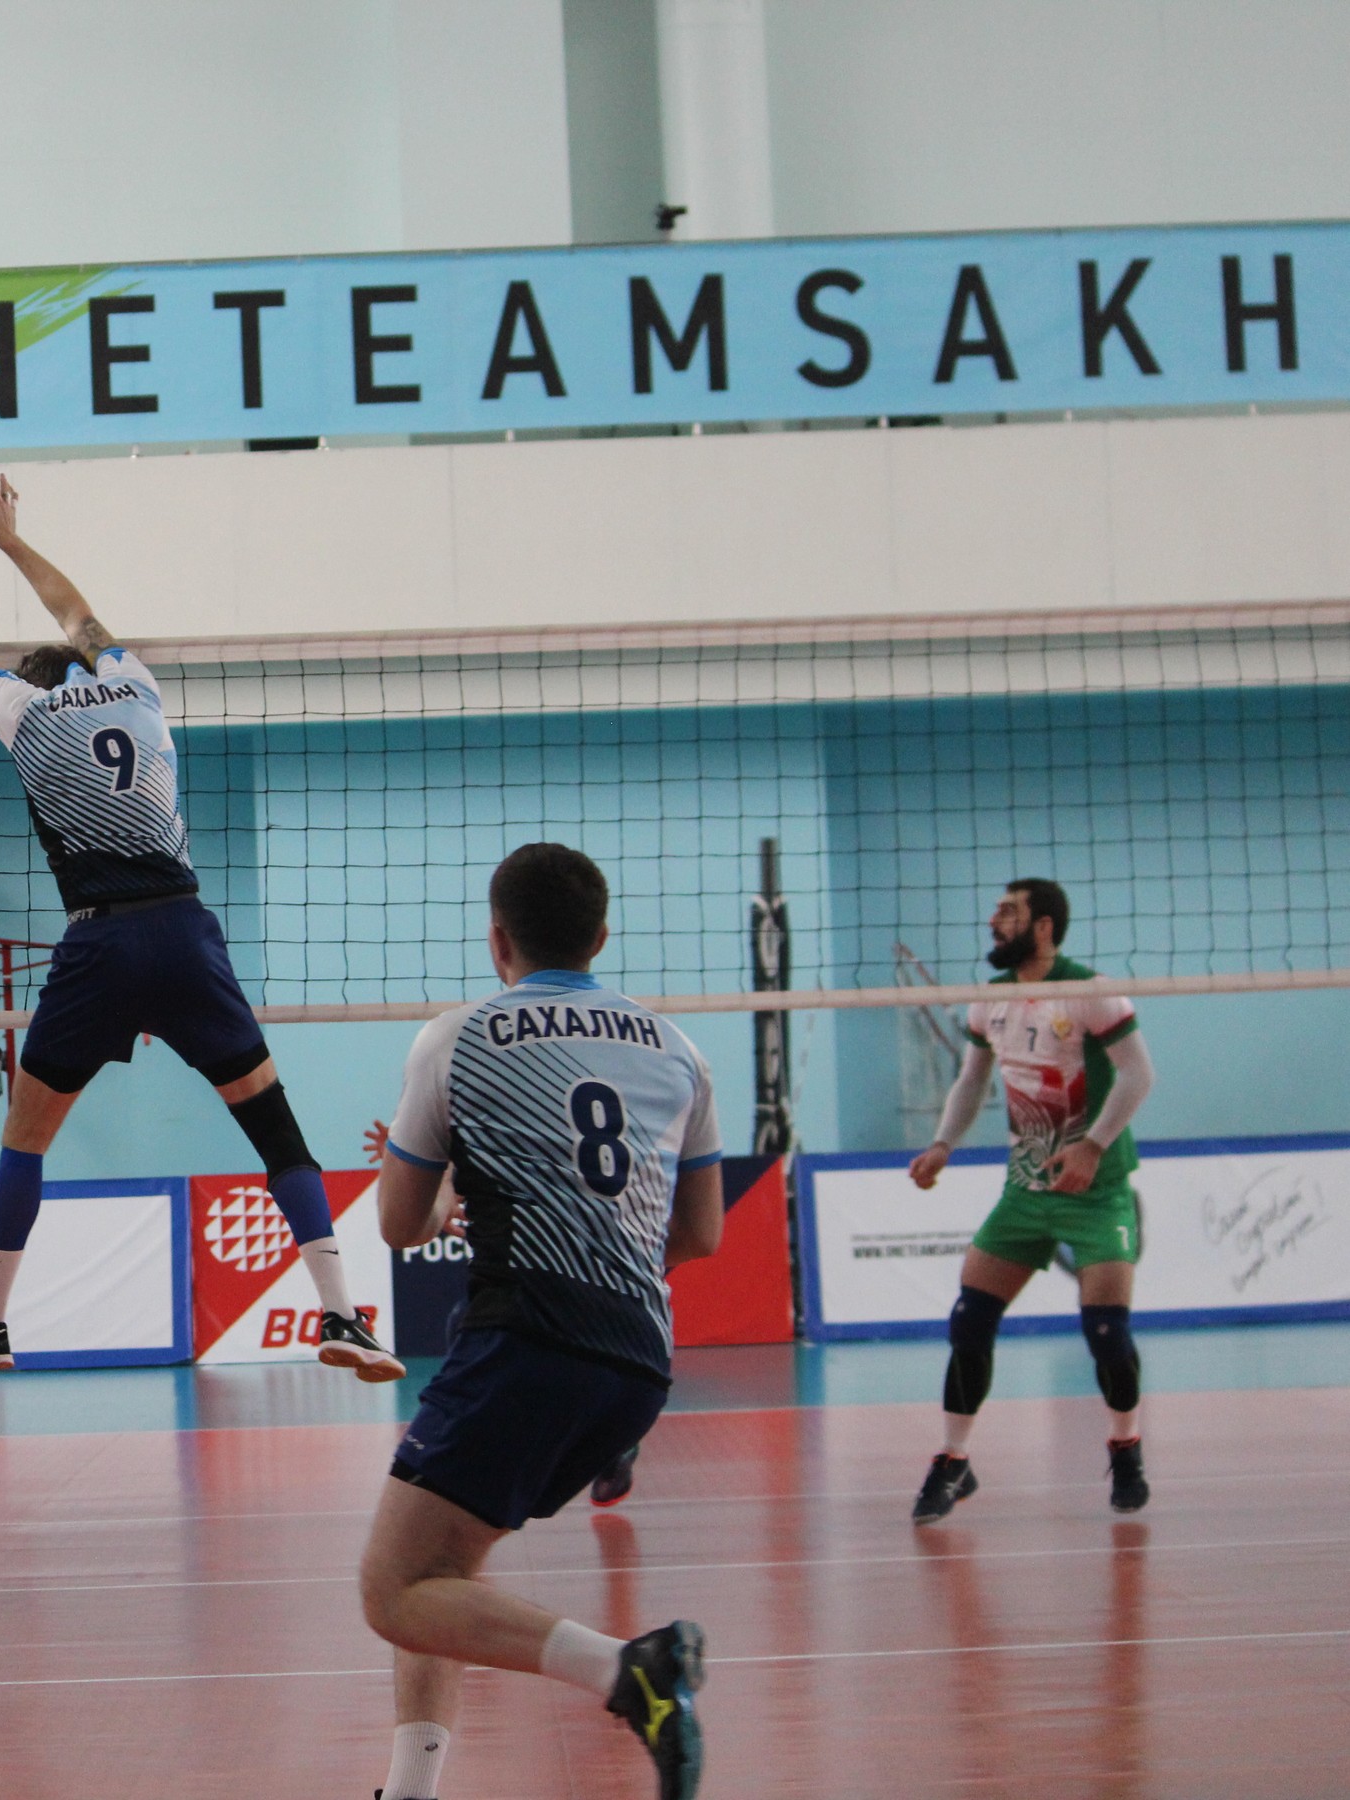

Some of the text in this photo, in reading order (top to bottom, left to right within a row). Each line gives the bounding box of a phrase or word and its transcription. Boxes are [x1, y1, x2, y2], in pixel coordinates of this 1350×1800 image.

[92, 727, 136, 793] 9
[488, 1005, 663, 1050] САХАЛИН
[1026, 1027, 1038, 1052] 7
[570, 1081, 631, 1197] 8
